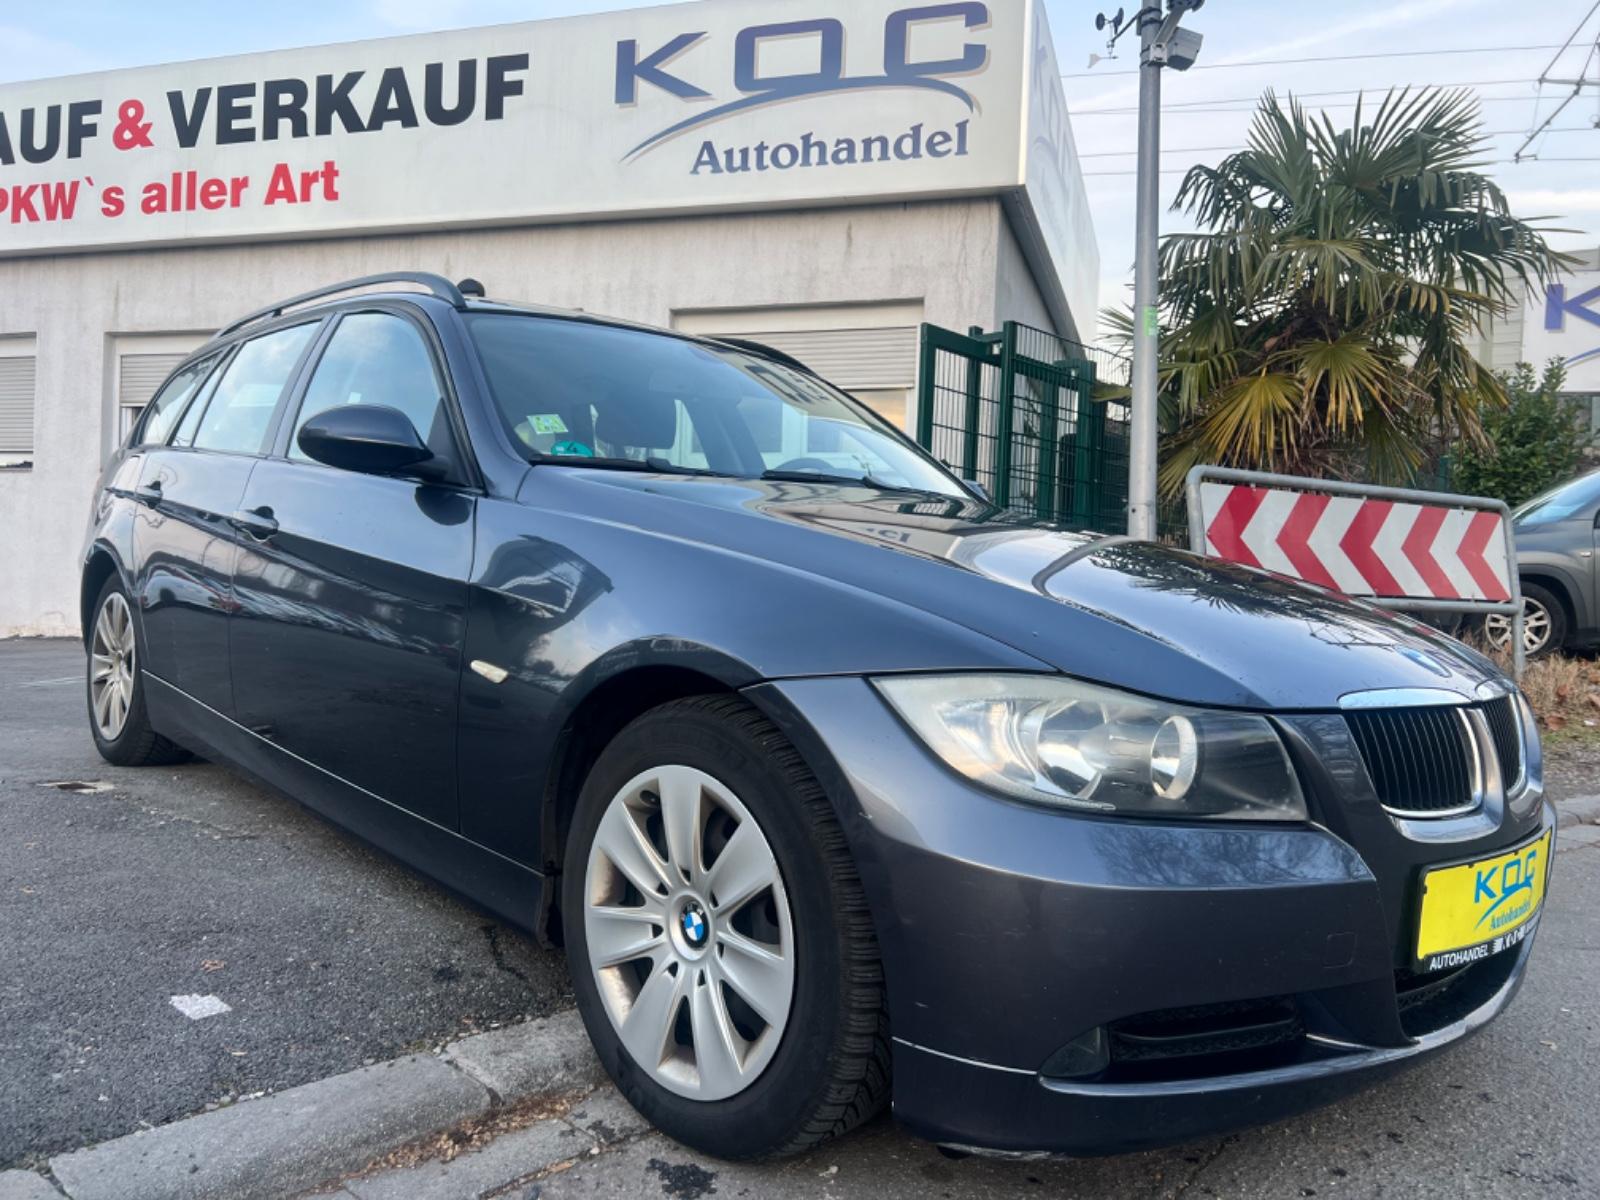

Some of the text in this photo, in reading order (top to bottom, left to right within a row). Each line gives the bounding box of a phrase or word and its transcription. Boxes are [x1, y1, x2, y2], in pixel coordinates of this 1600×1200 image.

[614, 1, 990, 105] KOC
[111, 98, 155, 151] &
[166, 53, 529, 149] VERKAUF
[689, 119, 969, 175] Autohandel
[140, 170, 250, 214] aller
[263, 160, 340, 206] Art
[1429, 944, 1489, 971] AUTOHANDEL
